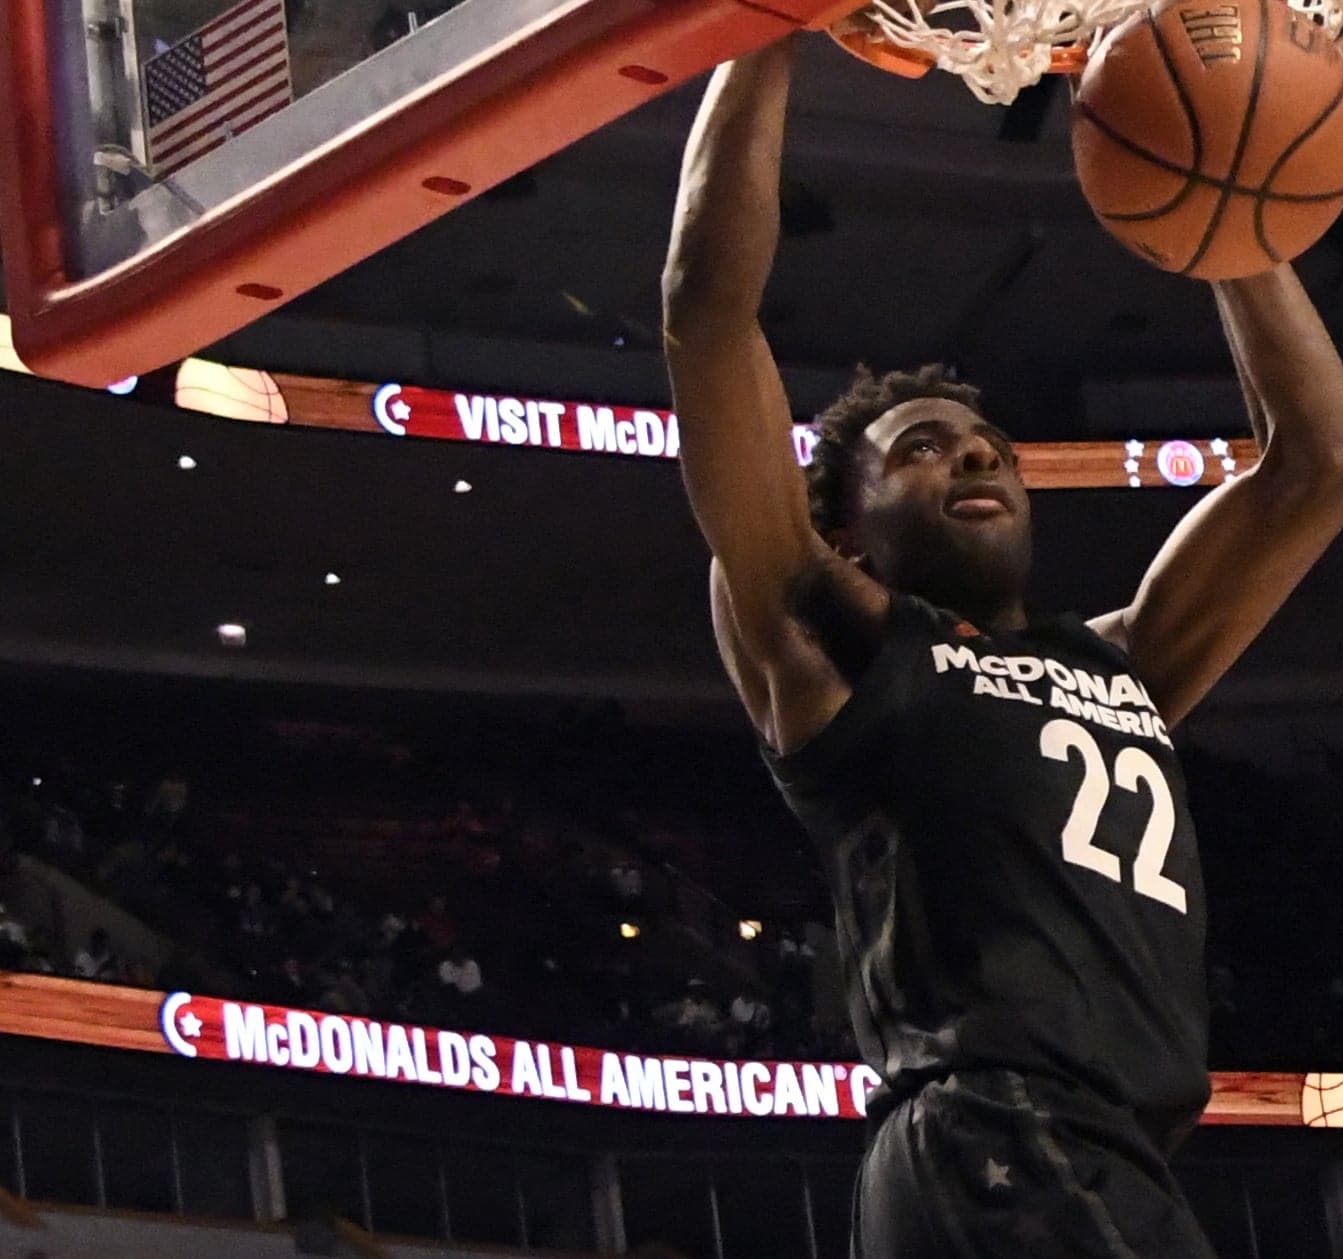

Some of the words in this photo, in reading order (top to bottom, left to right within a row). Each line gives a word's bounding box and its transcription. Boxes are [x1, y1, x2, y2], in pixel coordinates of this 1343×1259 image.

[1181, 5, 1242, 70] THE
[454, 393, 565, 446] VISIT
[931, 643, 1159, 714] McDONA
[973, 675, 1043, 706] ALL
[1050, 686, 1175, 751] AMERIC
[1039, 718, 1187, 915] 22
[222, 1002, 500, 1091] McDONALDS
[511, 1041, 592, 1102] ALL
